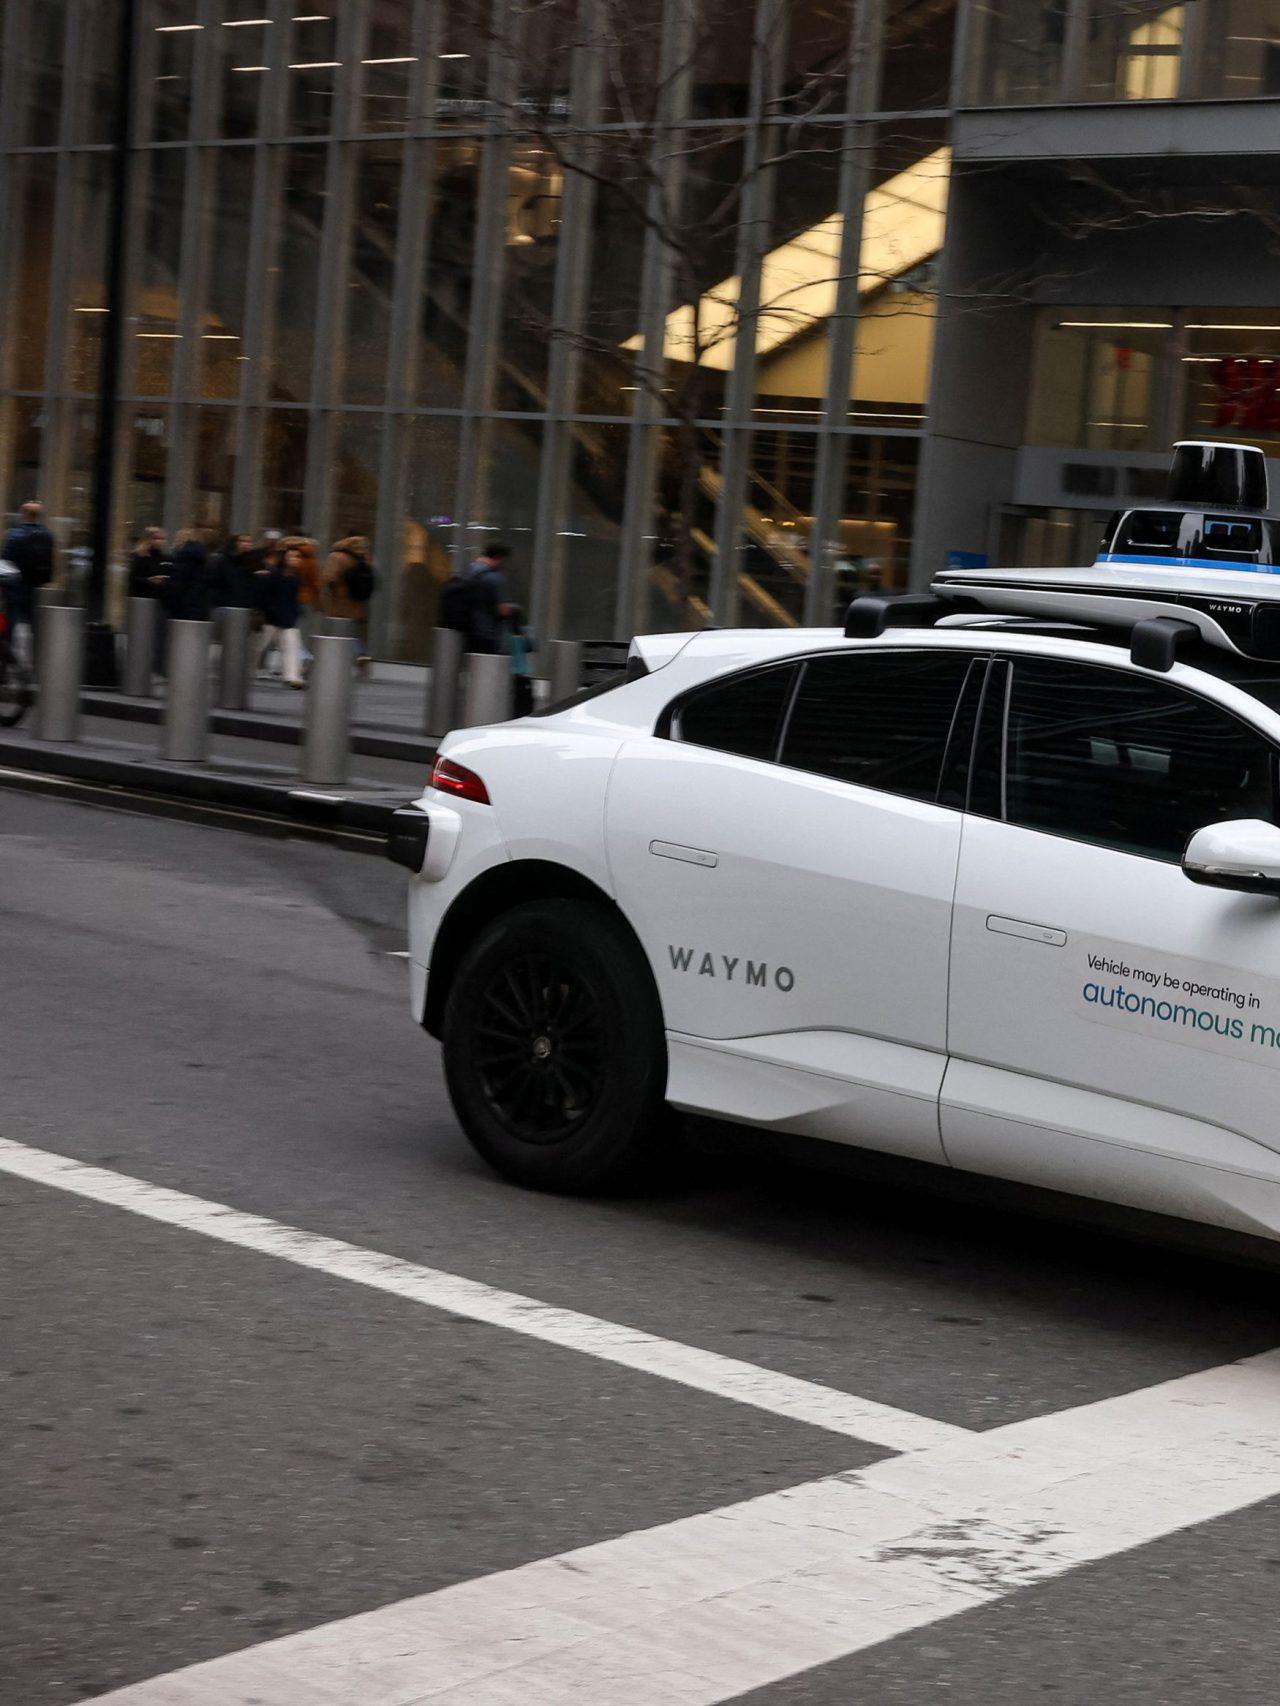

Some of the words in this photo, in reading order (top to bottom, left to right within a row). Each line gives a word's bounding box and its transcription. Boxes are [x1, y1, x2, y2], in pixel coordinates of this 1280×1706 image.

[1209, 604, 1242, 613] WAYMO
[668, 944, 795, 992] WAYMO
[1087, 953, 1130, 977] Vehicle
[1133, 968, 1162, 988] may
[1163, 972, 1180, 989] be
[1182, 981, 1246, 1009] operating
[1248, 993, 1261, 1009] in
[1083, 982, 1244, 1039] autonomous
